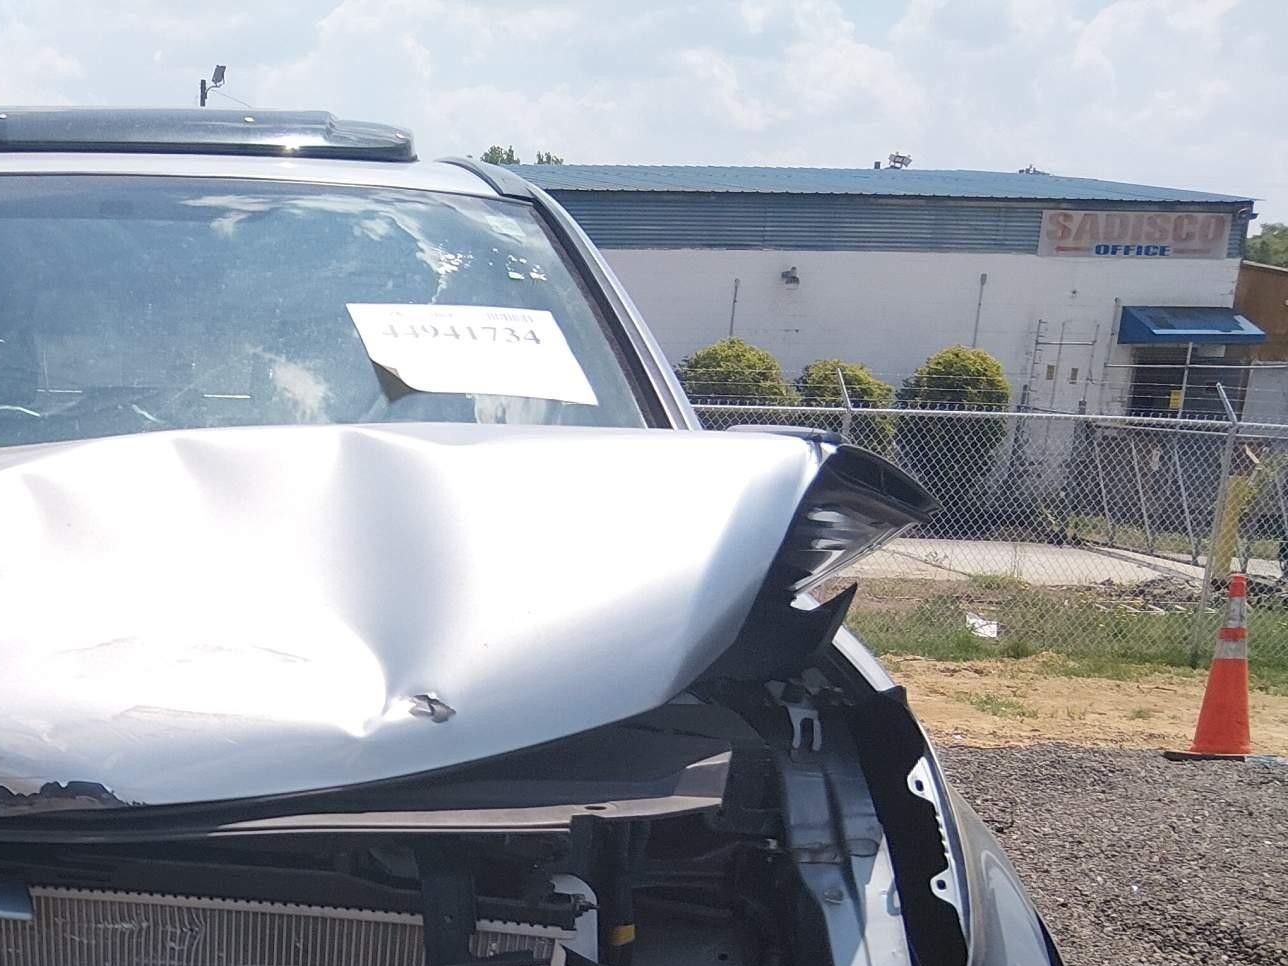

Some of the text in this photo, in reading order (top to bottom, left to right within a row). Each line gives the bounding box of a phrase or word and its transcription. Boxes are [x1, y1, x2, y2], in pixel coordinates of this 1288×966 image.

[1047, 212, 1225, 241] SADISCO
[1095, 244, 1171, 257] OFFICE
[381, 324, 542, 345] 44941734
